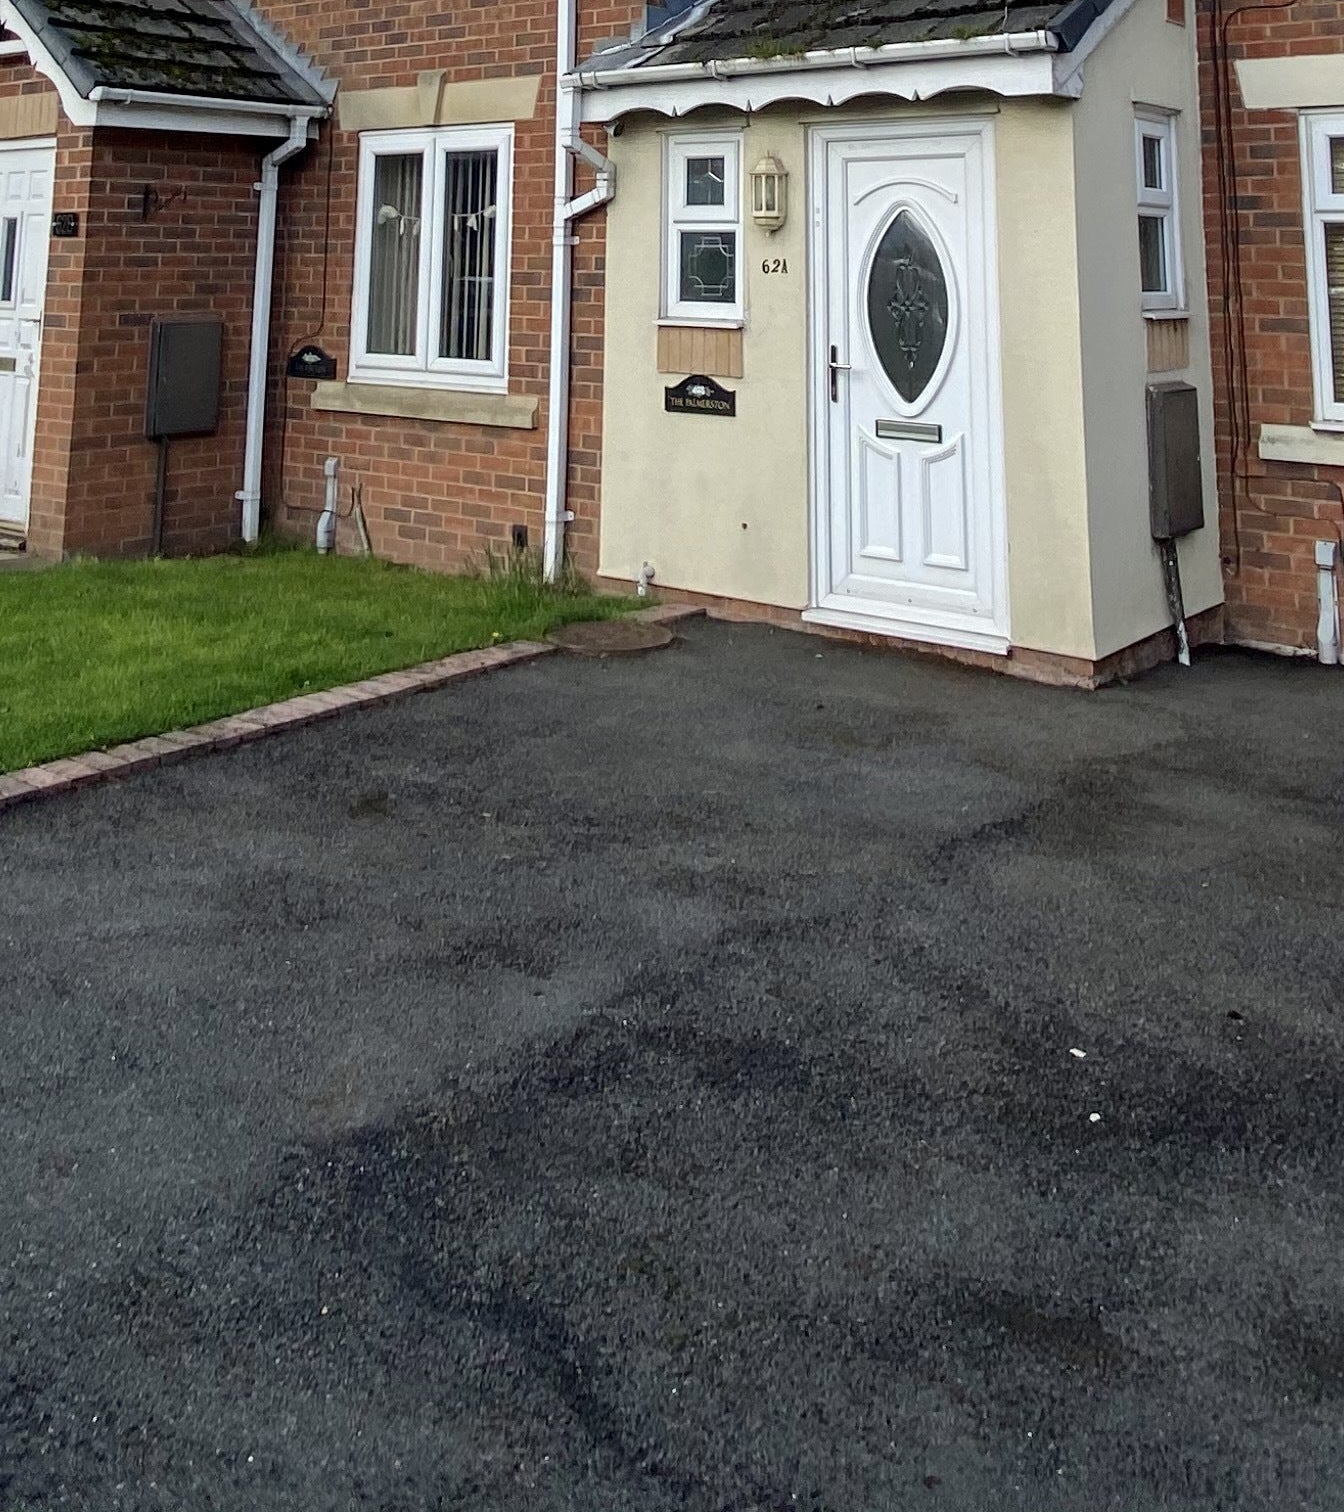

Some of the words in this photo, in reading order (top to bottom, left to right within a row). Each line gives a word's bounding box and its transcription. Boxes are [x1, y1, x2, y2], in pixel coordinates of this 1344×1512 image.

[761, 258, 788, 274] 62A
[670, 396, 684, 407] THE
[685, 398, 731, 410] PALMERSTON
